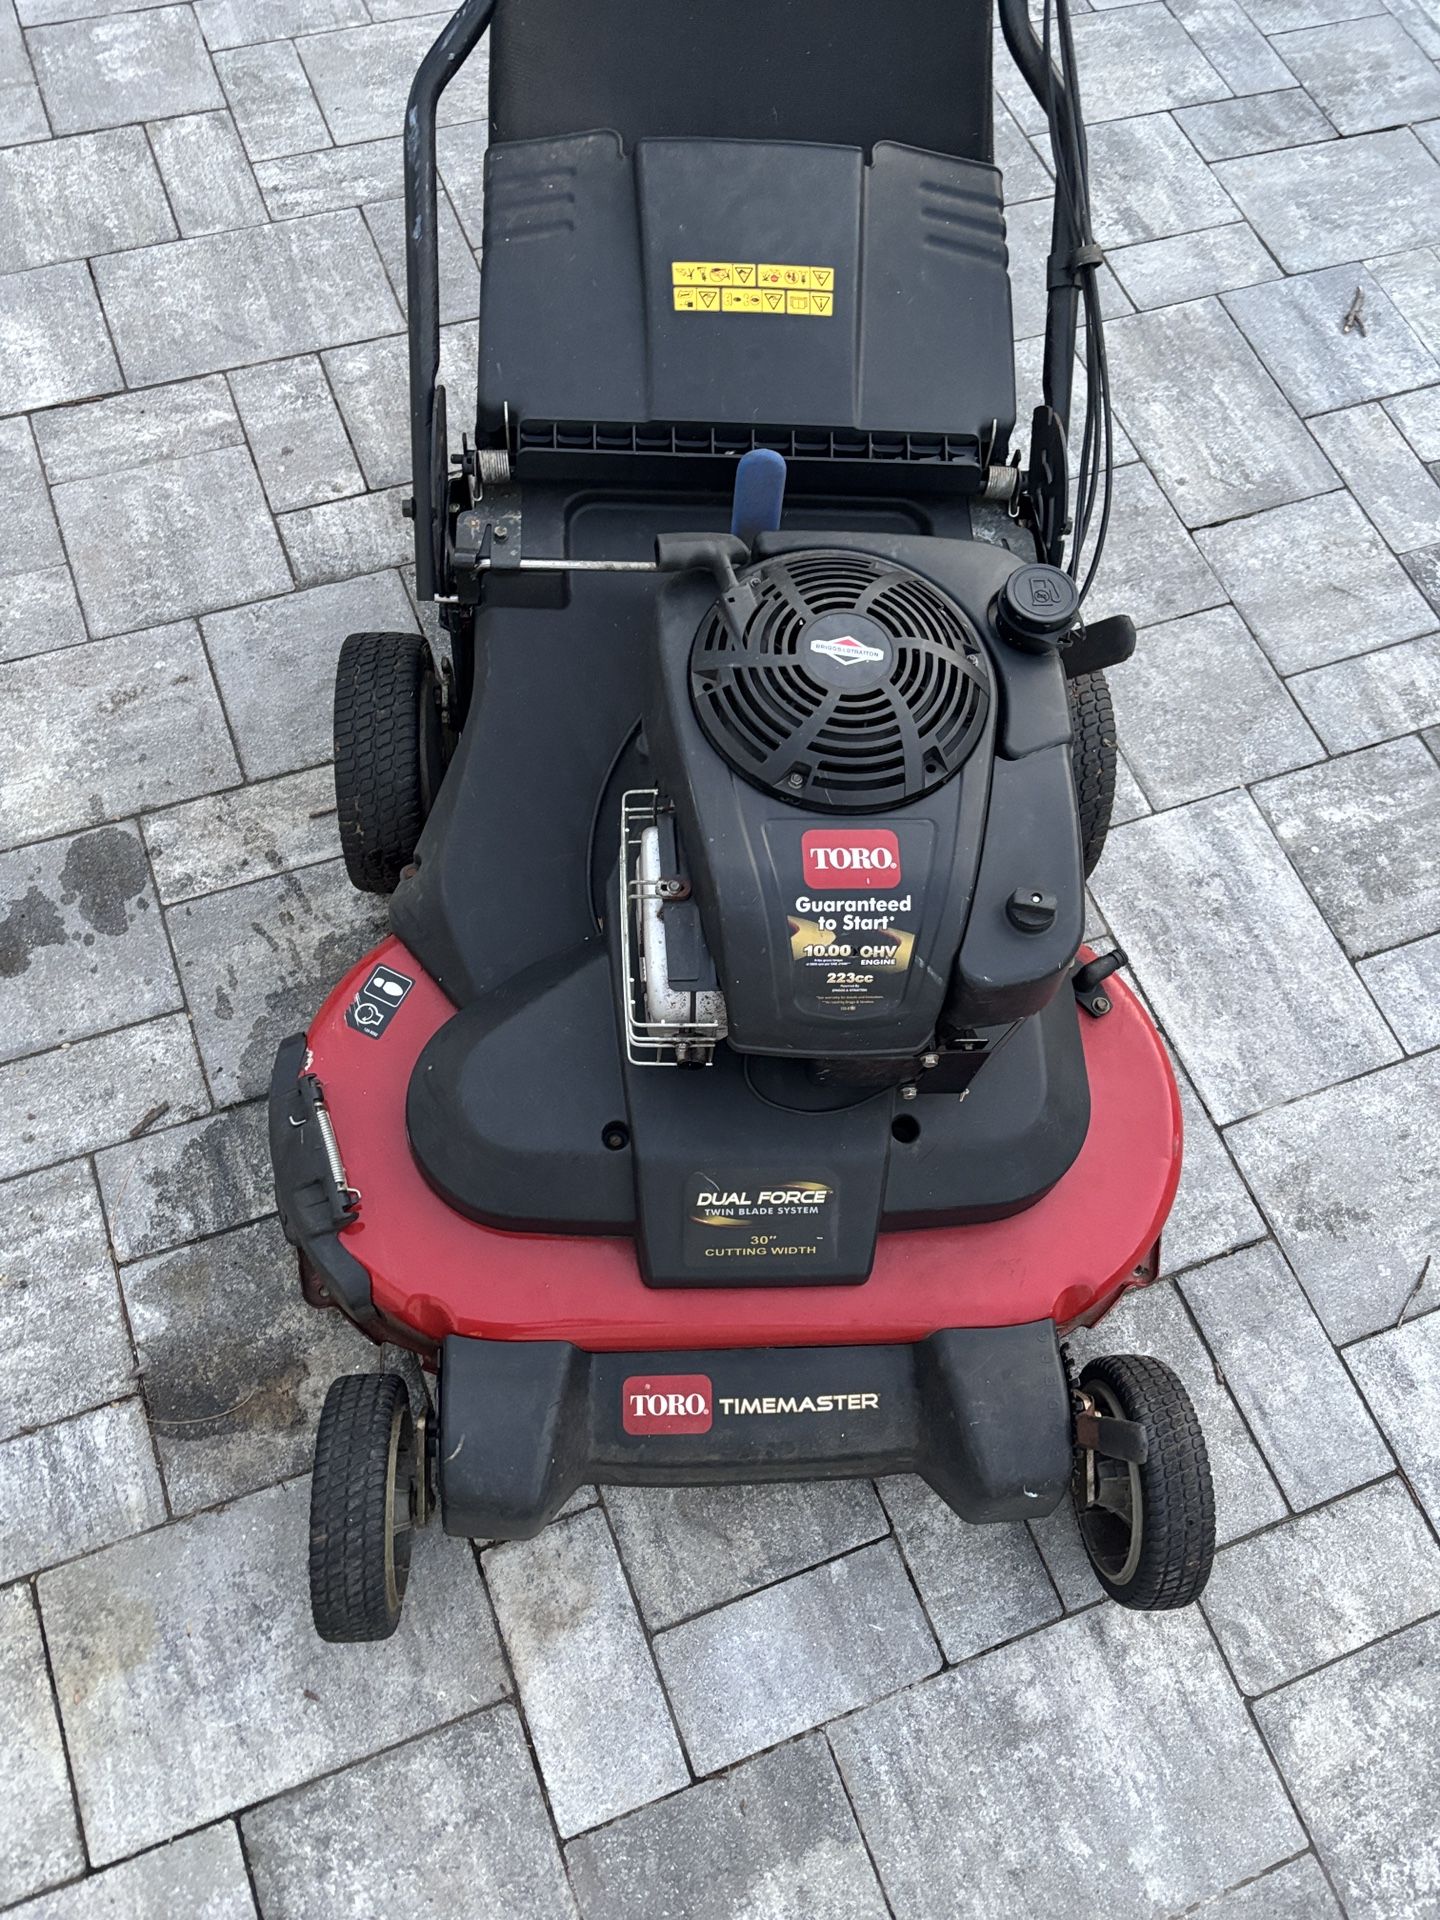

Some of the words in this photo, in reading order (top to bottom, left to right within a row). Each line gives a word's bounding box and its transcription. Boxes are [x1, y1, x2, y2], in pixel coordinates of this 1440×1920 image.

[795, 895, 911, 912] Guaranteed
[818, 917, 838, 930] to
[804, 944, 852, 957] 10.00
[860, 945, 897, 958] OHV
[826, 972, 874, 984] 223cc
[697, 1193, 752, 1206] DUAL
[705, 1208, 734, 1216] TWIN
[738, 1207, 774, 1215] BLADE
[777, 1206, 819, 1215] SYSTEM
[705, 1248, 767, 1257] CUTTING
[771, 1246, 816, 1255] WIDTH
[719, 1393, 880, 1415] TIMEMASTER
